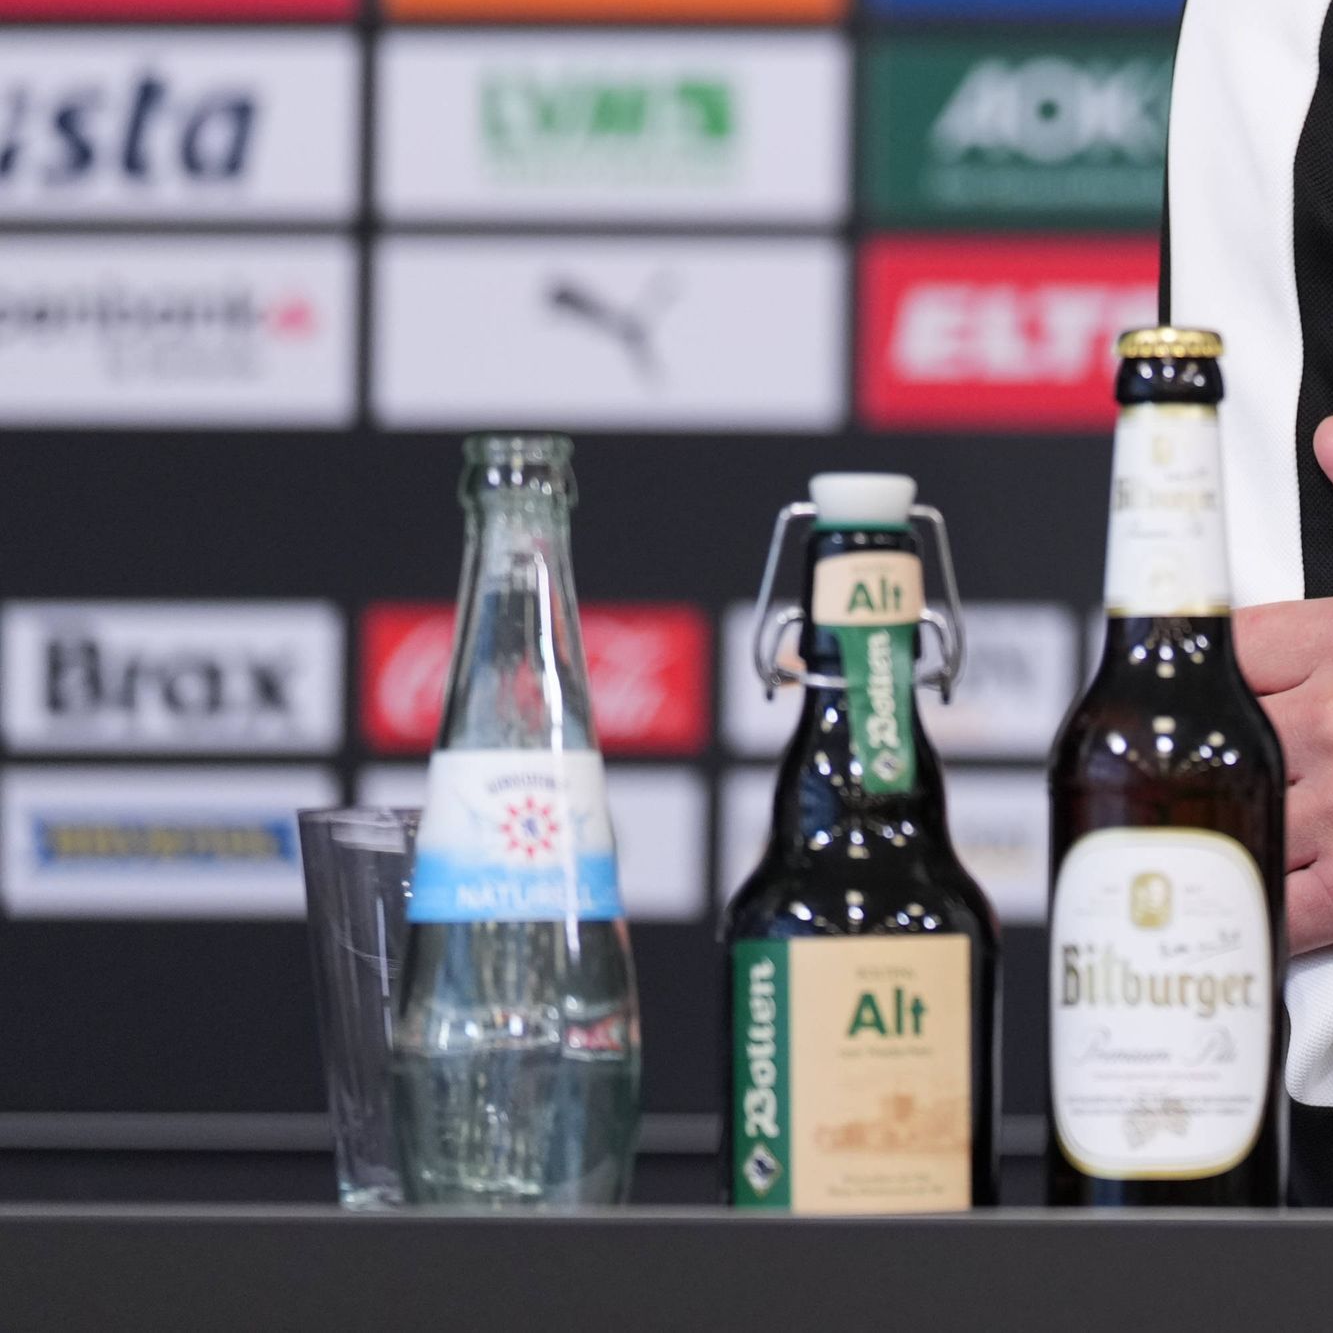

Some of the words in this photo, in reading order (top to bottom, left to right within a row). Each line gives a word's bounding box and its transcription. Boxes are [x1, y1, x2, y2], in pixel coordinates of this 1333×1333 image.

[930, 55, 1170, 164] AOK
[889, 279, 1162, 385] ELT
[847, 576, 905, 614] Alt
[43, 621, 297, 719] Brax
[457, 881, 595, 912] NATUREL
[847, 984, 928, 1038] Alt
